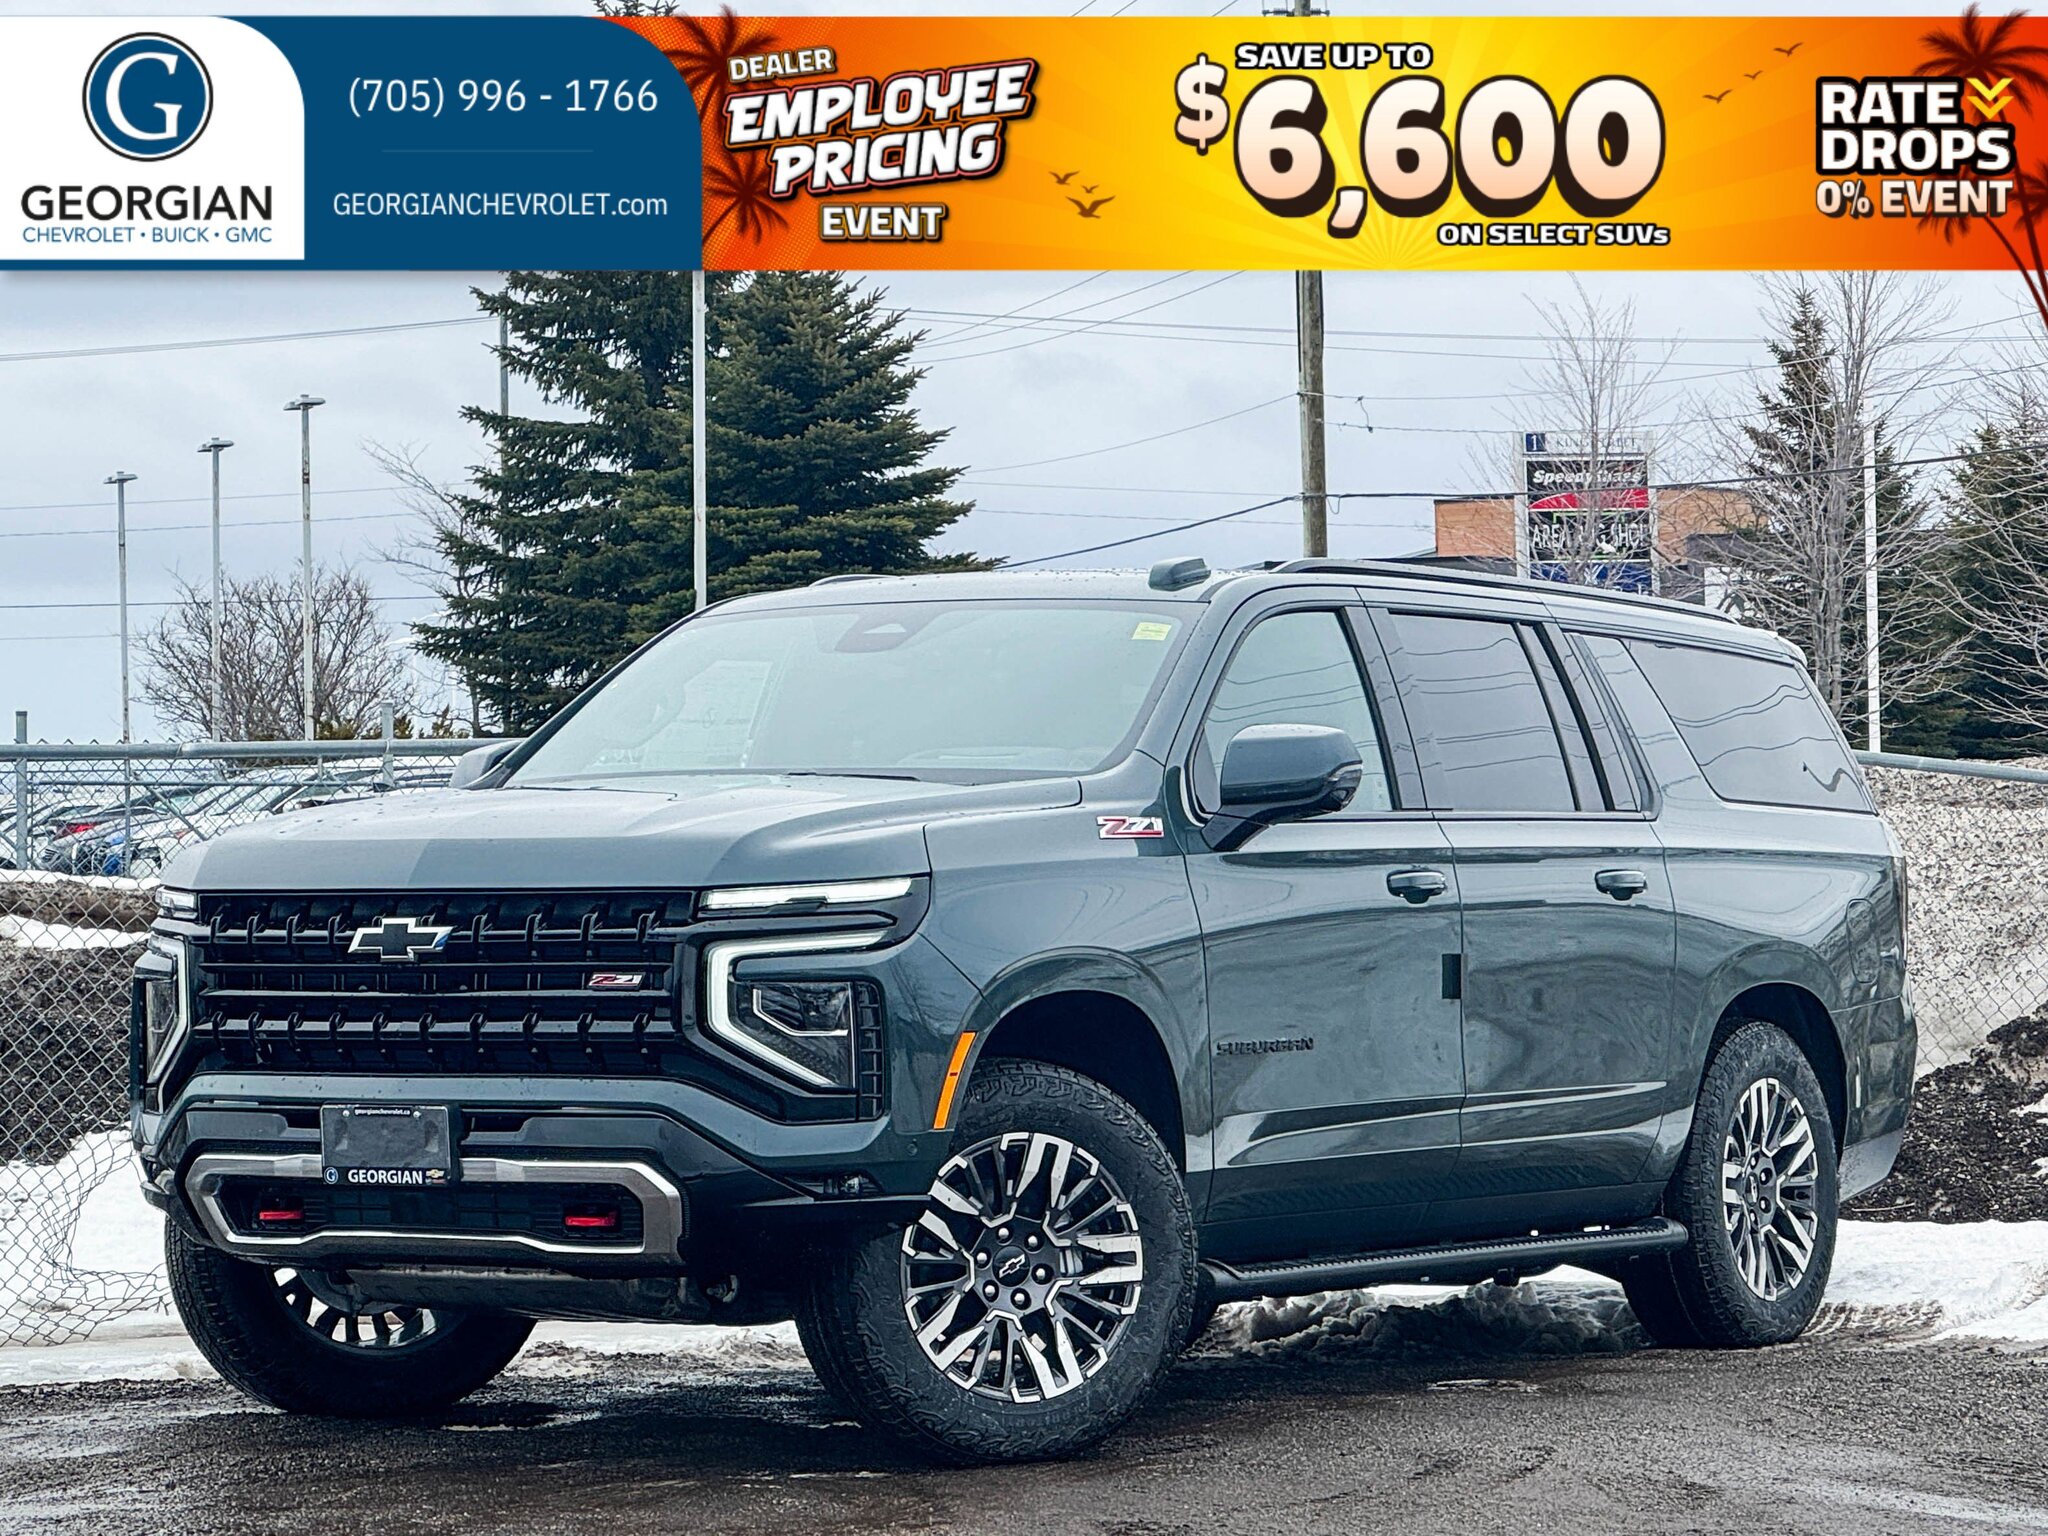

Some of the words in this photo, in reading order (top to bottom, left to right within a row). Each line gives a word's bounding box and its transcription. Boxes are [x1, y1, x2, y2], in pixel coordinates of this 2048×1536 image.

[1096, 816, 1164, 839] Z71
[1216, 1037, 1314, 1055] SUBURBAN
[347, 1168, 423, 1184] GEORGIAN
